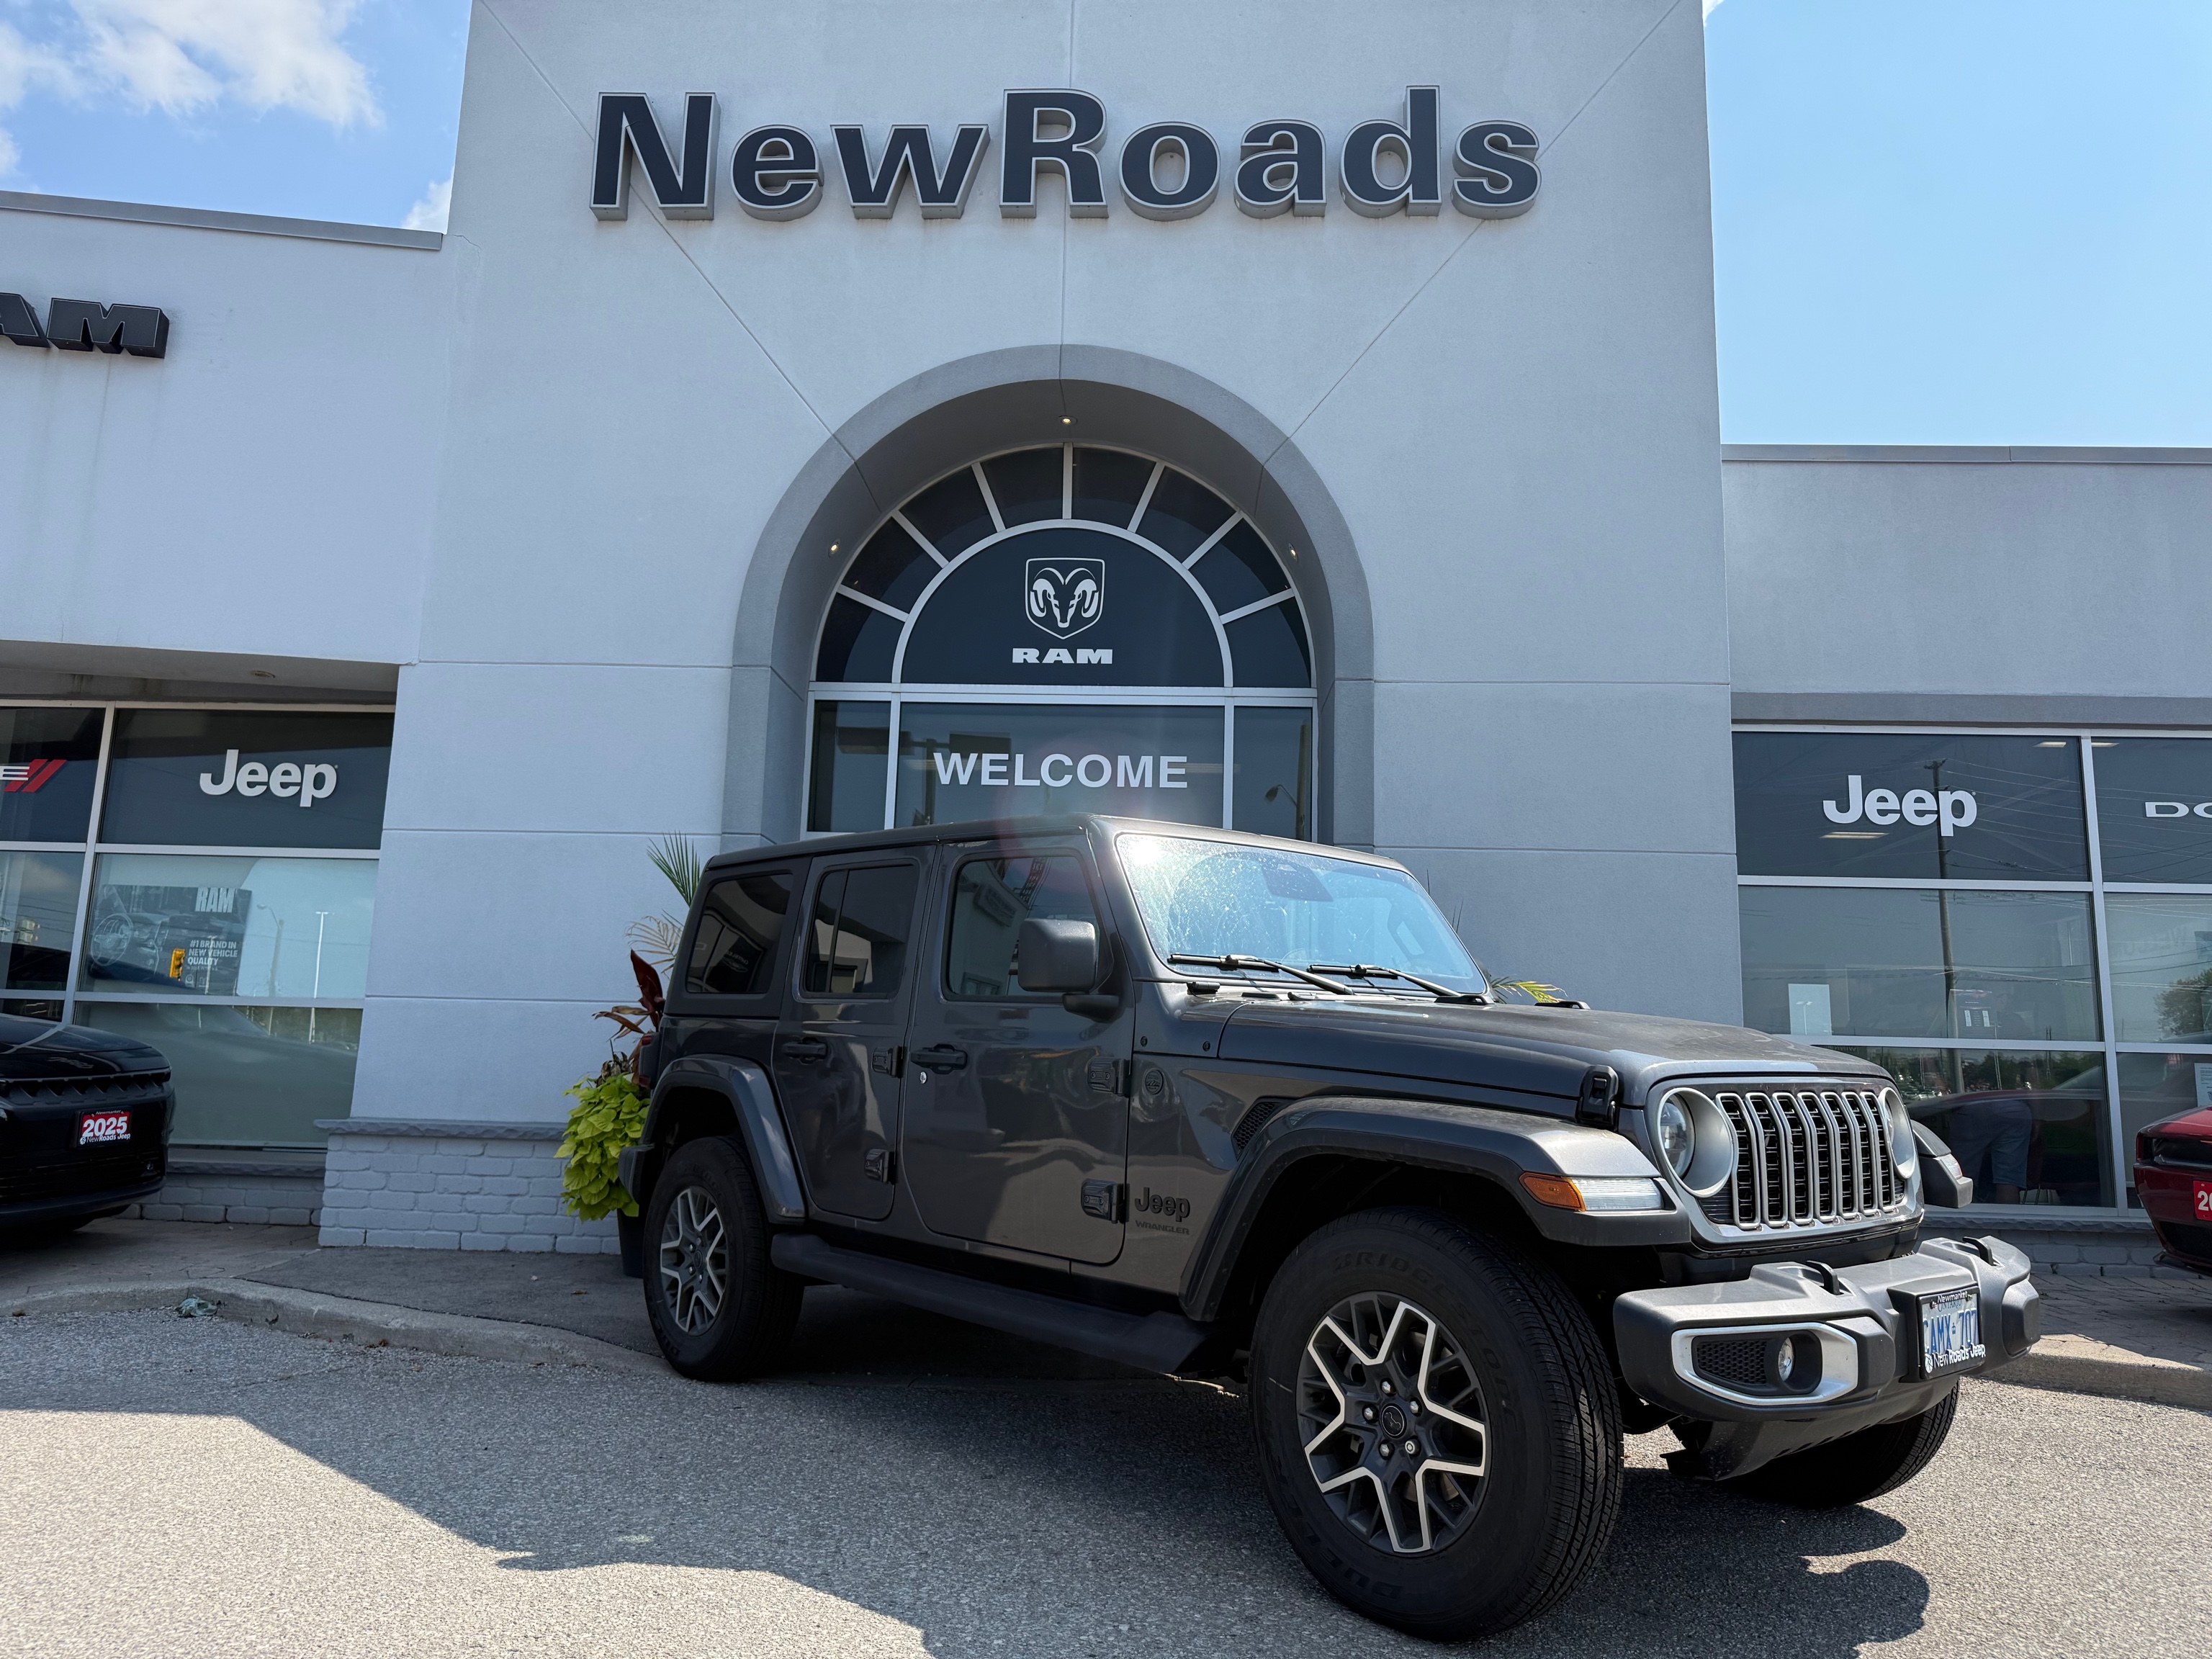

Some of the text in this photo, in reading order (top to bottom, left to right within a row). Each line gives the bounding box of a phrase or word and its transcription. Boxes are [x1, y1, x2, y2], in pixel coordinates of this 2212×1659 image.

[589, 85, 1542, 220] NewRoads
[1012, 647, 1113, 664] RAM
[199, 749, 337, 807] Jeep
[933, 752, 1188, 788] WELCOME
[1822, 775, 1977, 837] Jeep
[195, 887, 235, 913] RAM
[187, 957, 219, 966] QUALITY
[208, 949, 238, 958] VEHICLE
[82, 1116, 128, 1138] 2025
[1134, 1187, 1190, 1223] Jeep
[1136, 1219, 1190, 1236] WRANGLER
[1937, 1291, 1968, 1304] Newmarket
[1958, 1308, 1978, 1349] 707
[1970, 1343, 1986, 1359] Jeep
